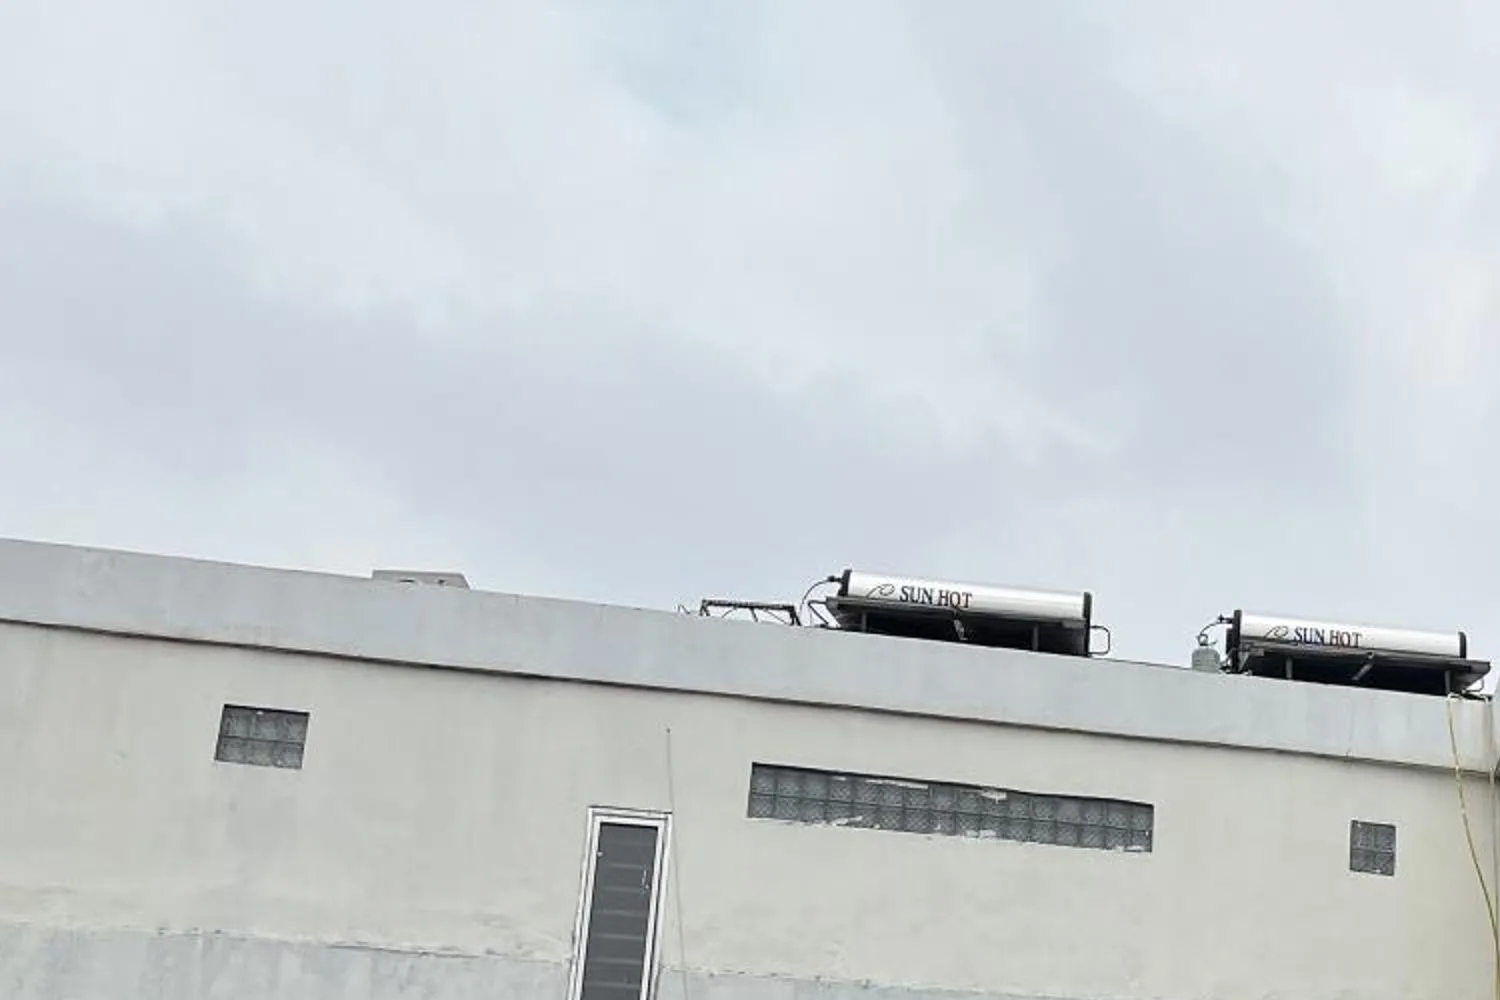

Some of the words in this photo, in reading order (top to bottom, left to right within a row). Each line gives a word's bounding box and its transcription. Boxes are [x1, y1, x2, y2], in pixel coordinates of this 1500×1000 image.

[899, 585, 934, 605] SUN
[938, 589, 973, 609] HOT
[1293, 626, 1326, 646] SUN
[1329, 629, 1363, 649] HOT
